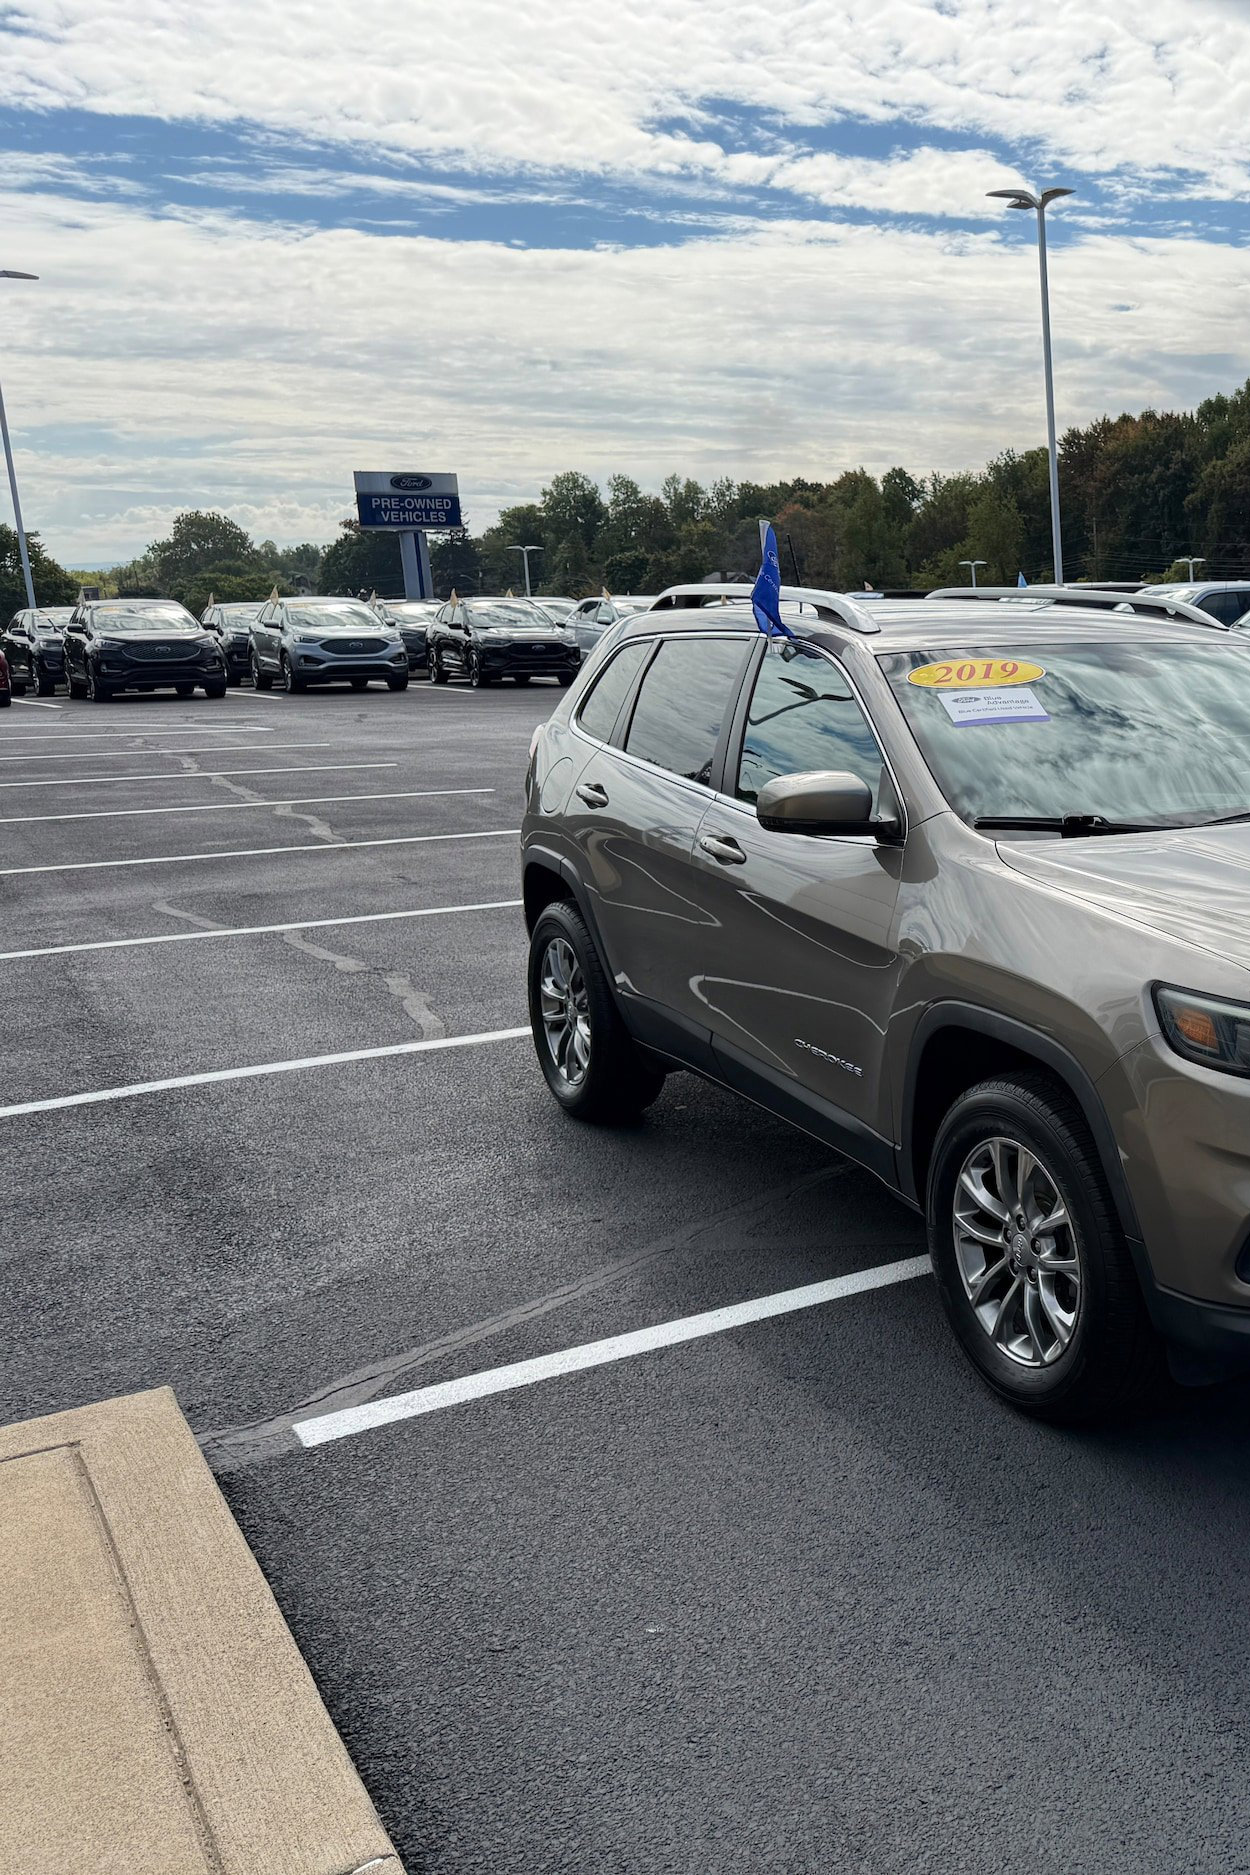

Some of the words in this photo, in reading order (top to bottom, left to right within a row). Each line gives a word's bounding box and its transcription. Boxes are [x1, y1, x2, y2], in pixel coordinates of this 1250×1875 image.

[399, 477, 424, 487] Ford
[371, 497, 452, 510] PRE-OWNED
[380, 510, 447, 523] VEHICLES
[933, 661, 1019, 684] 2019
